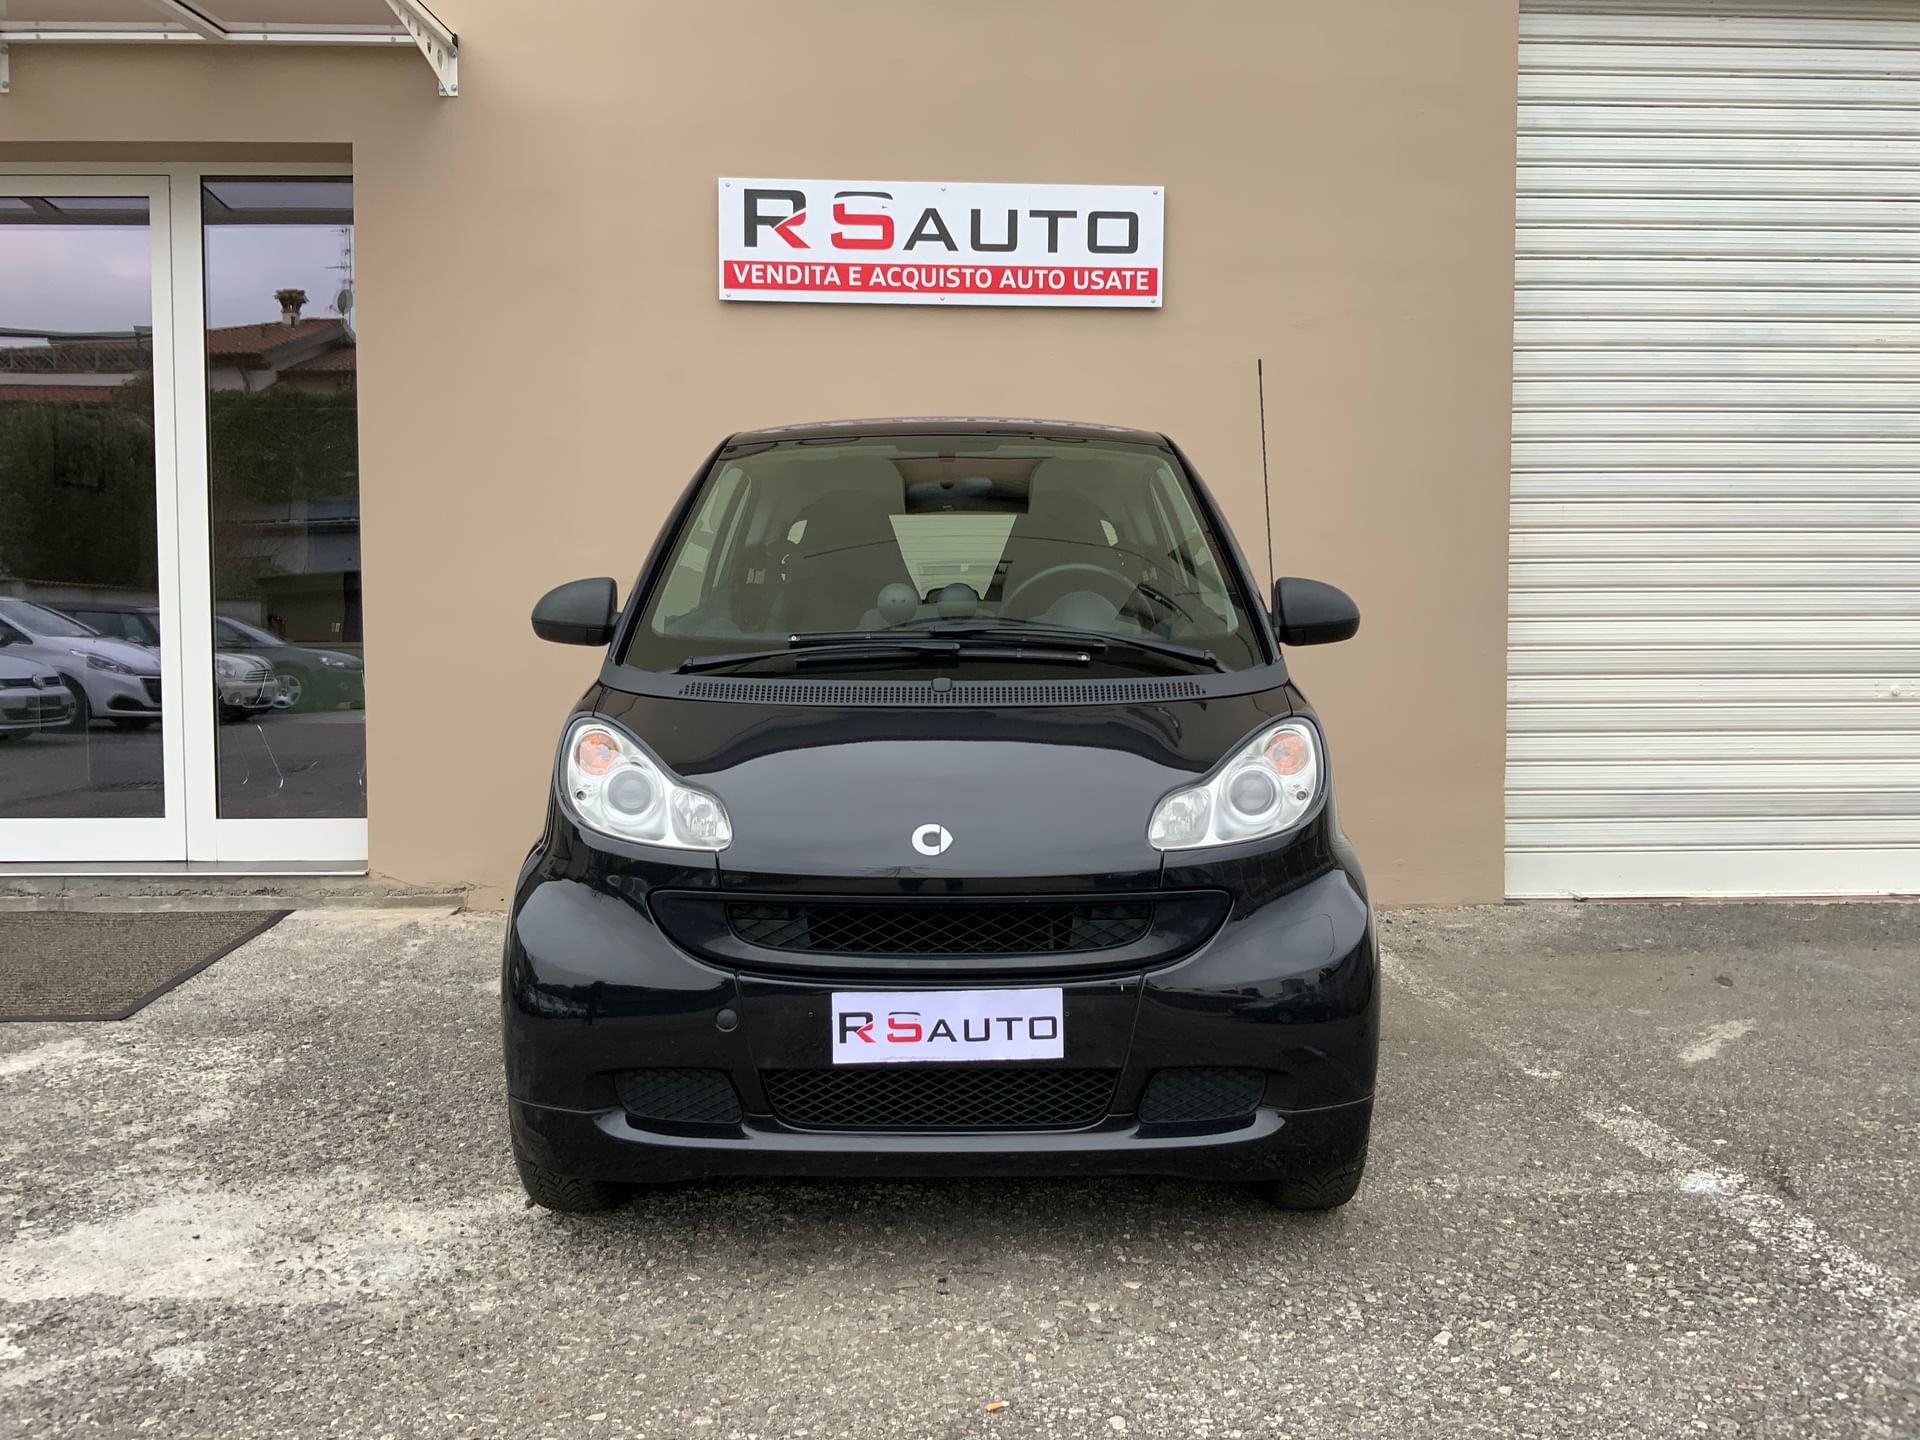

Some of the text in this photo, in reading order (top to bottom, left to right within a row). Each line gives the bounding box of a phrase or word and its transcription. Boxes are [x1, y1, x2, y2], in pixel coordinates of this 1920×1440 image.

[733, 263, 1149, 291] VENDITA E ACQUISTO AUTO USATE
